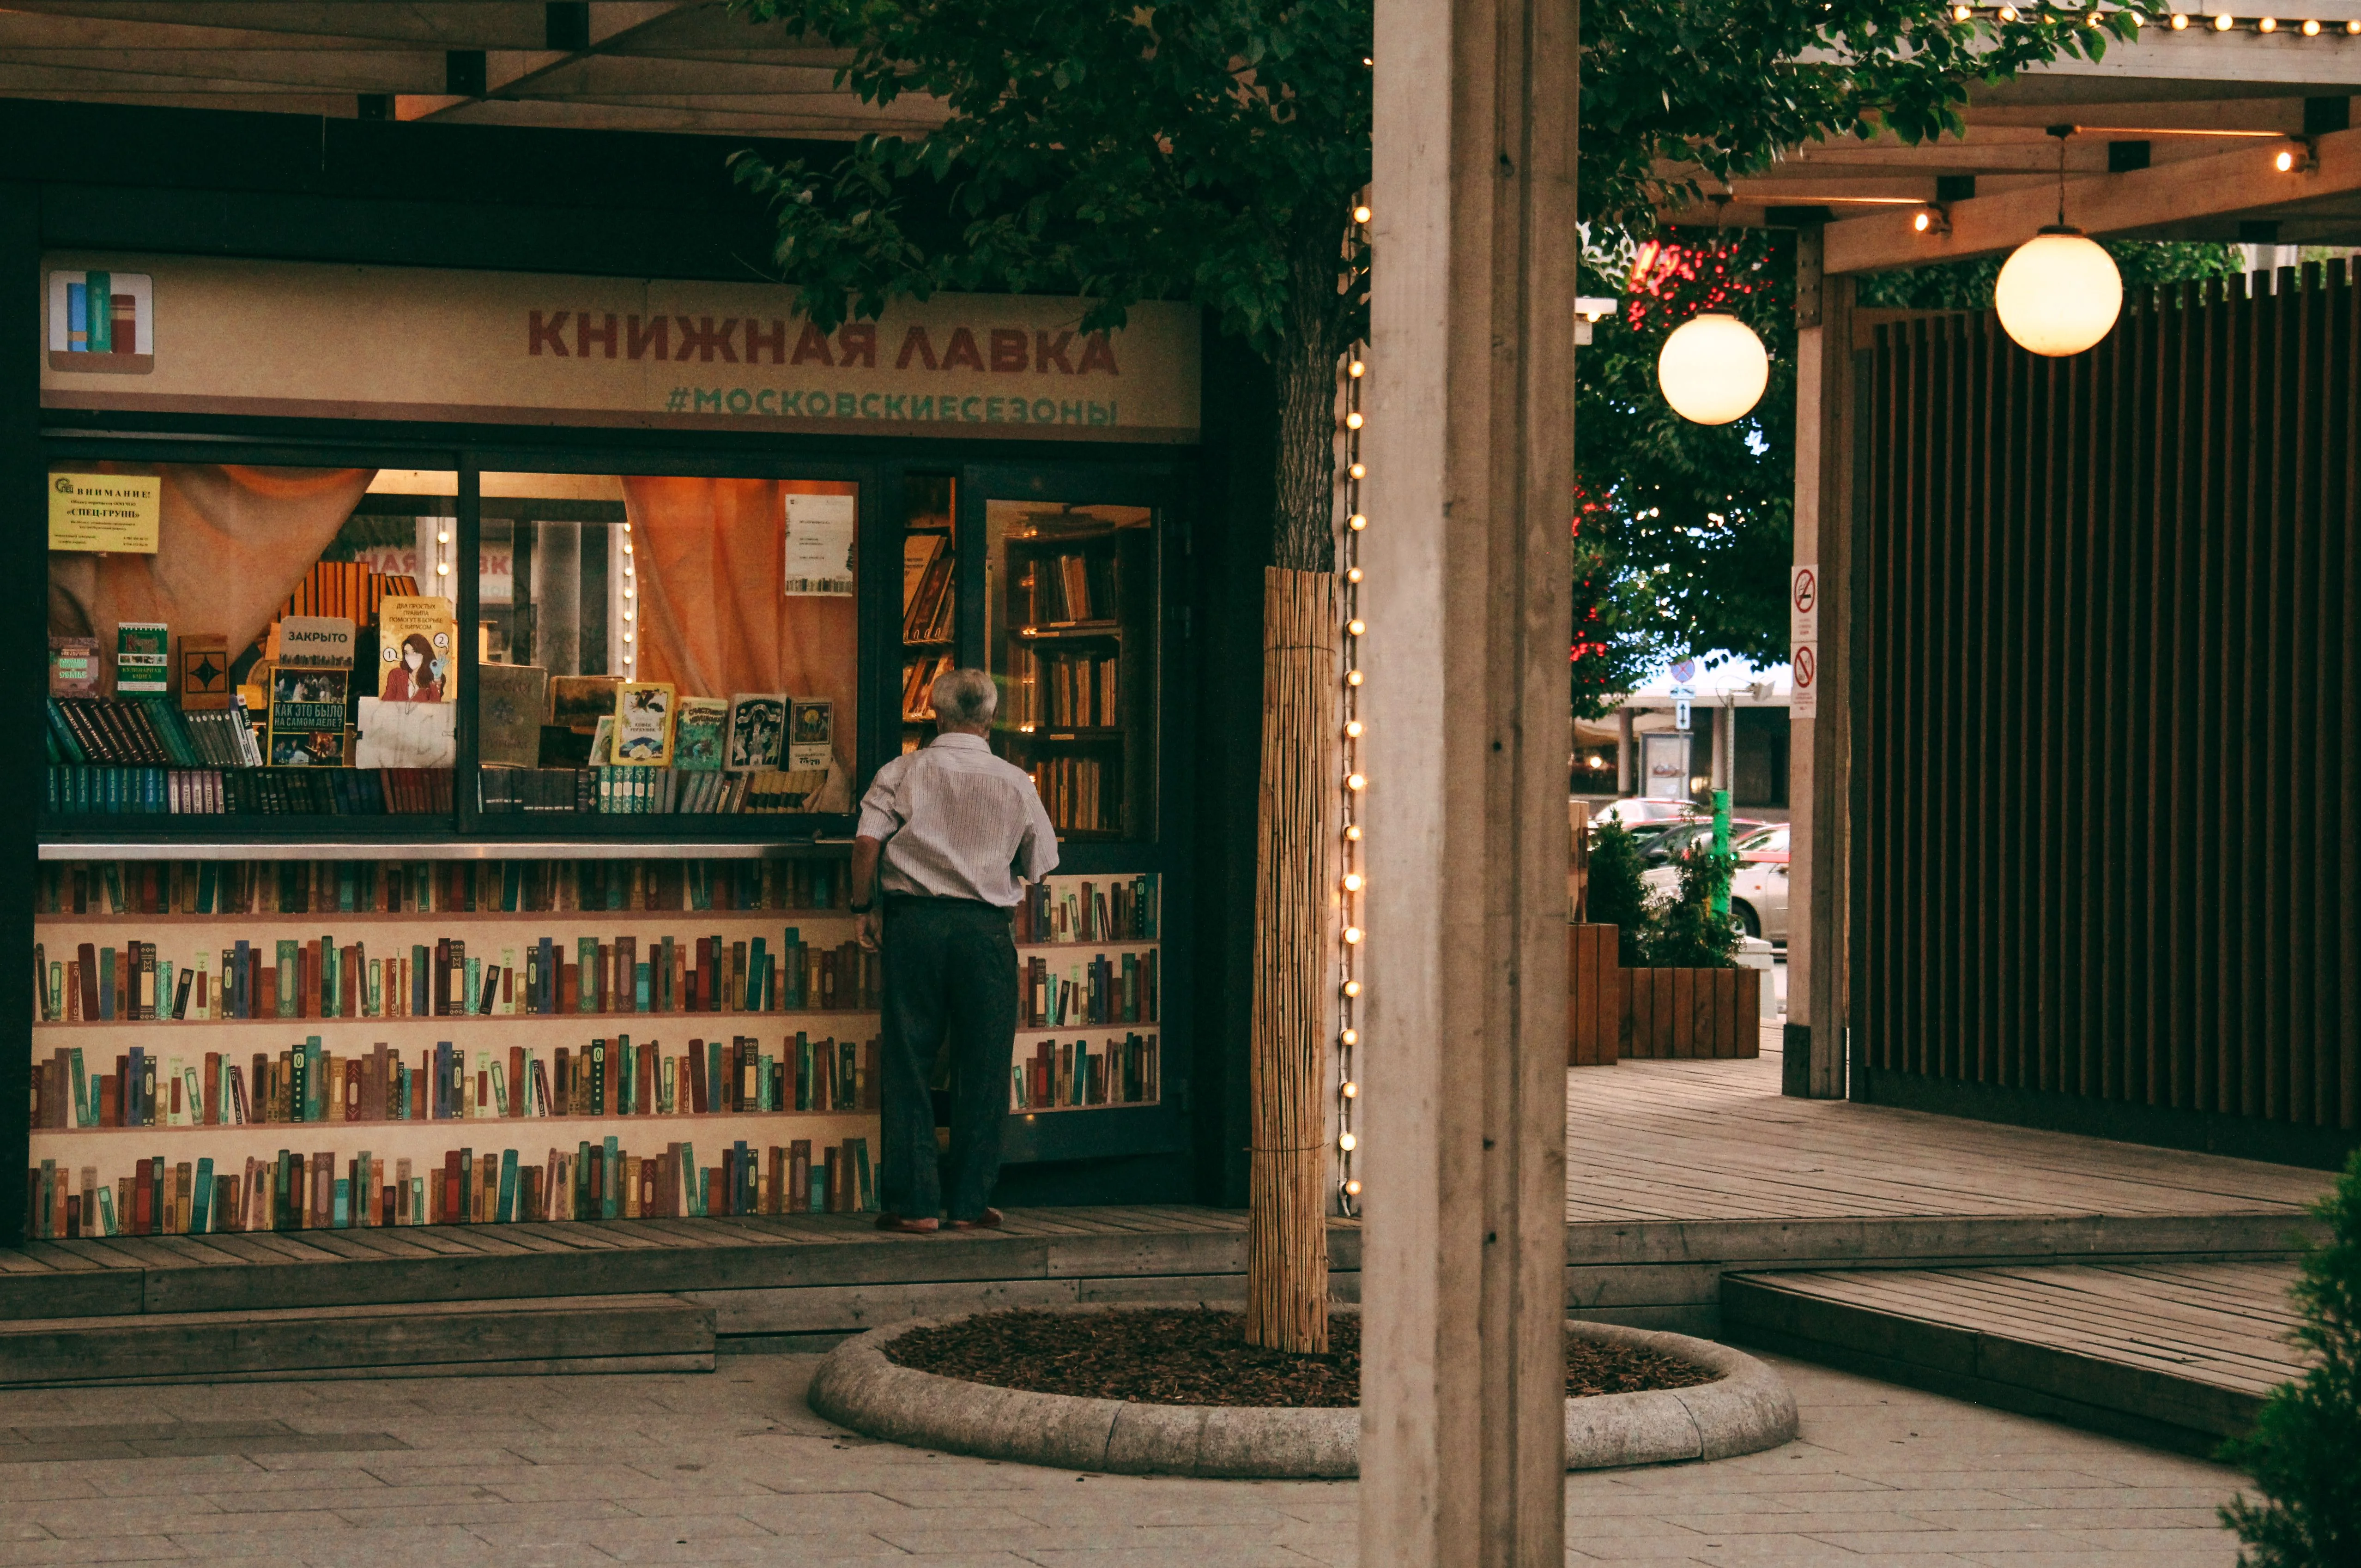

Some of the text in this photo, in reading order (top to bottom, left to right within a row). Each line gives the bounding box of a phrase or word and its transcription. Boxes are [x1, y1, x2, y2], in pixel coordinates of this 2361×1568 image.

[528, 310, 1120, 375] КНИЖНАЯ ЛАВКА
[665, 387, 1118, 426] #МОСКОВСКИЕСЕЗОНЫ
[78, 488, 151, 498] ВНИМАНИЕ!
[67, 508, 139, 518] «СПЕЦ-ГРУПП»
[288, 632, 347, 643] ЗАКРЫТО
[275, 704, 343, 718] КАК ЭТО БЫЛО
[275, 718, 285, 726] НА
[286, 718, 315, 726] САМОМ
